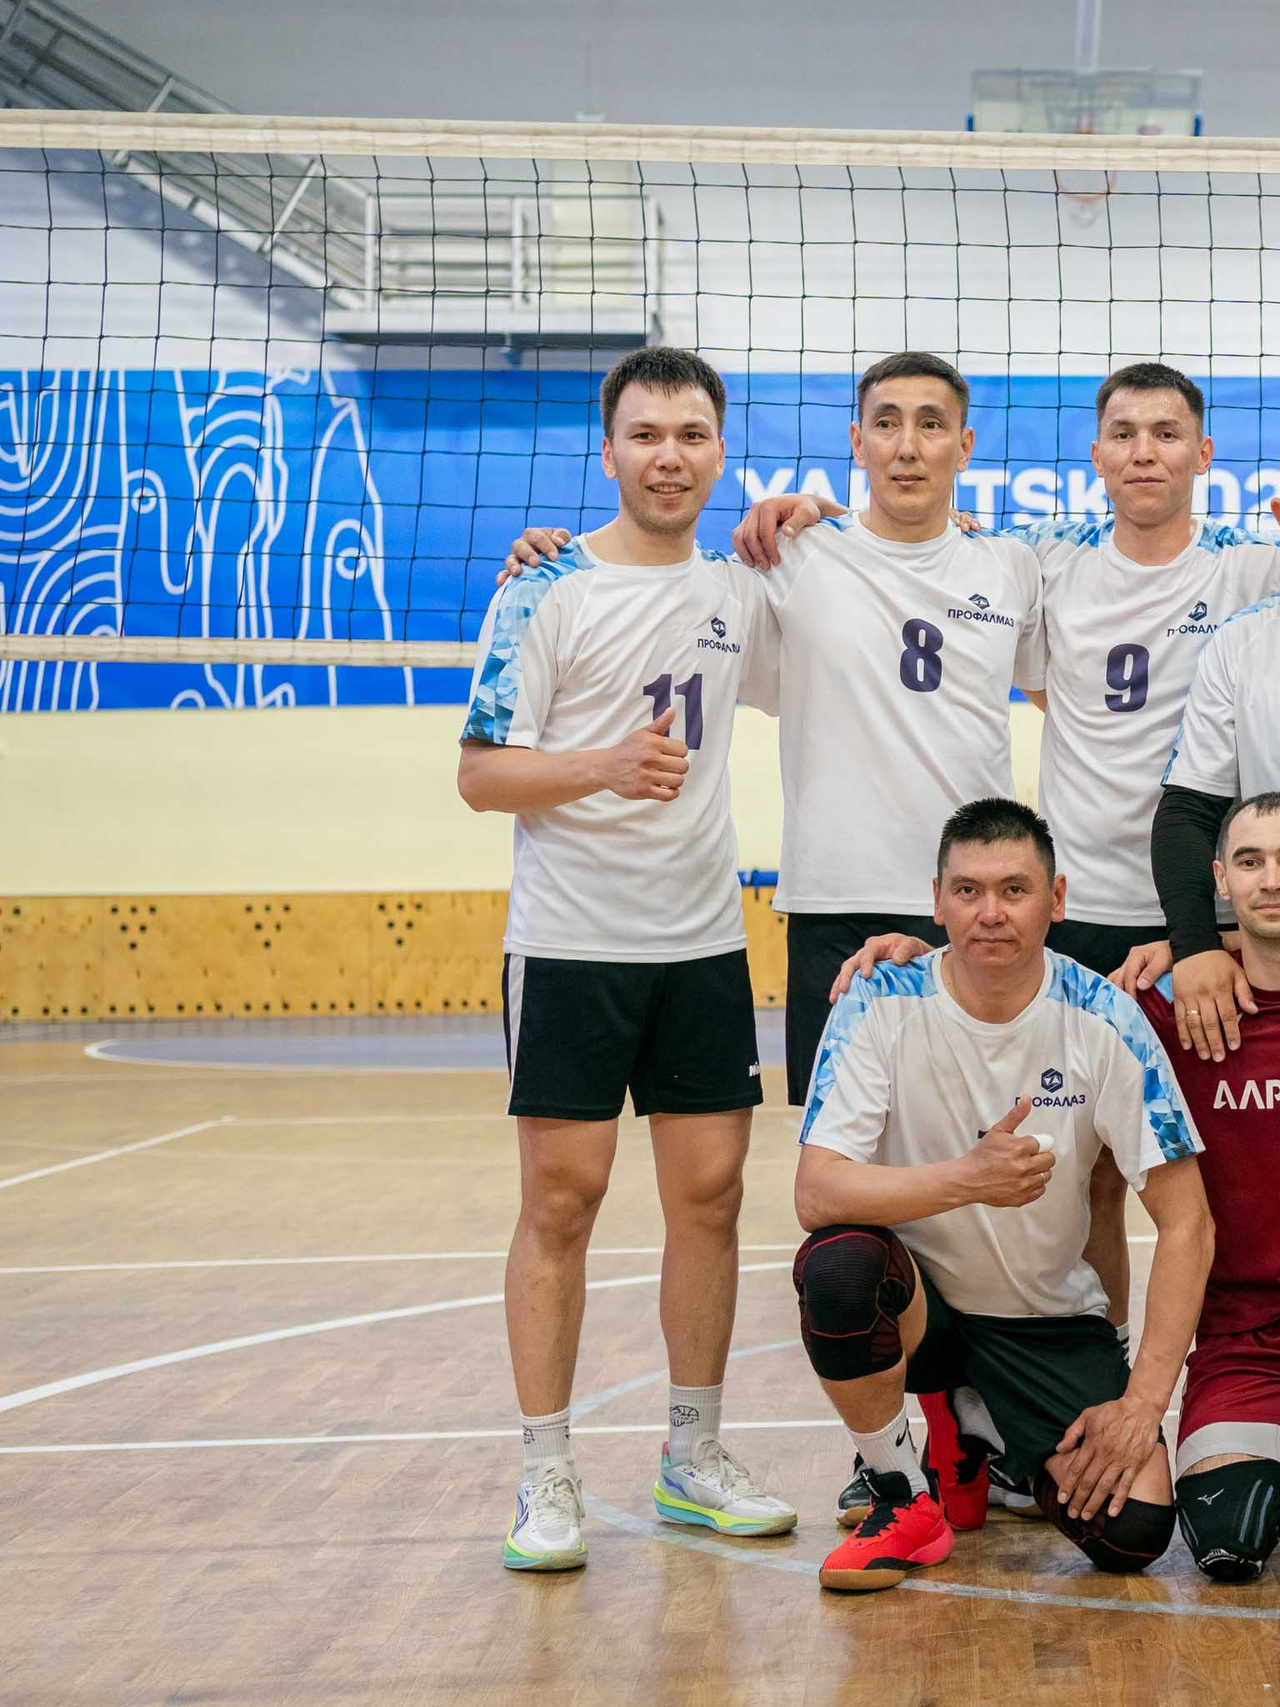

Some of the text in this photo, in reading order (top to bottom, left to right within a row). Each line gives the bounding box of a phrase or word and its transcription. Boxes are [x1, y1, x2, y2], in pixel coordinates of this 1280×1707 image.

[735, 468, 1115, 529] YATSK
[947, 608, 1015, 627] ПРОФАЛМАЗ
[900, 618, 943, 692] 8
[1105, 643, 1149, 712] 9
[643, 673, 703, 750] 11
